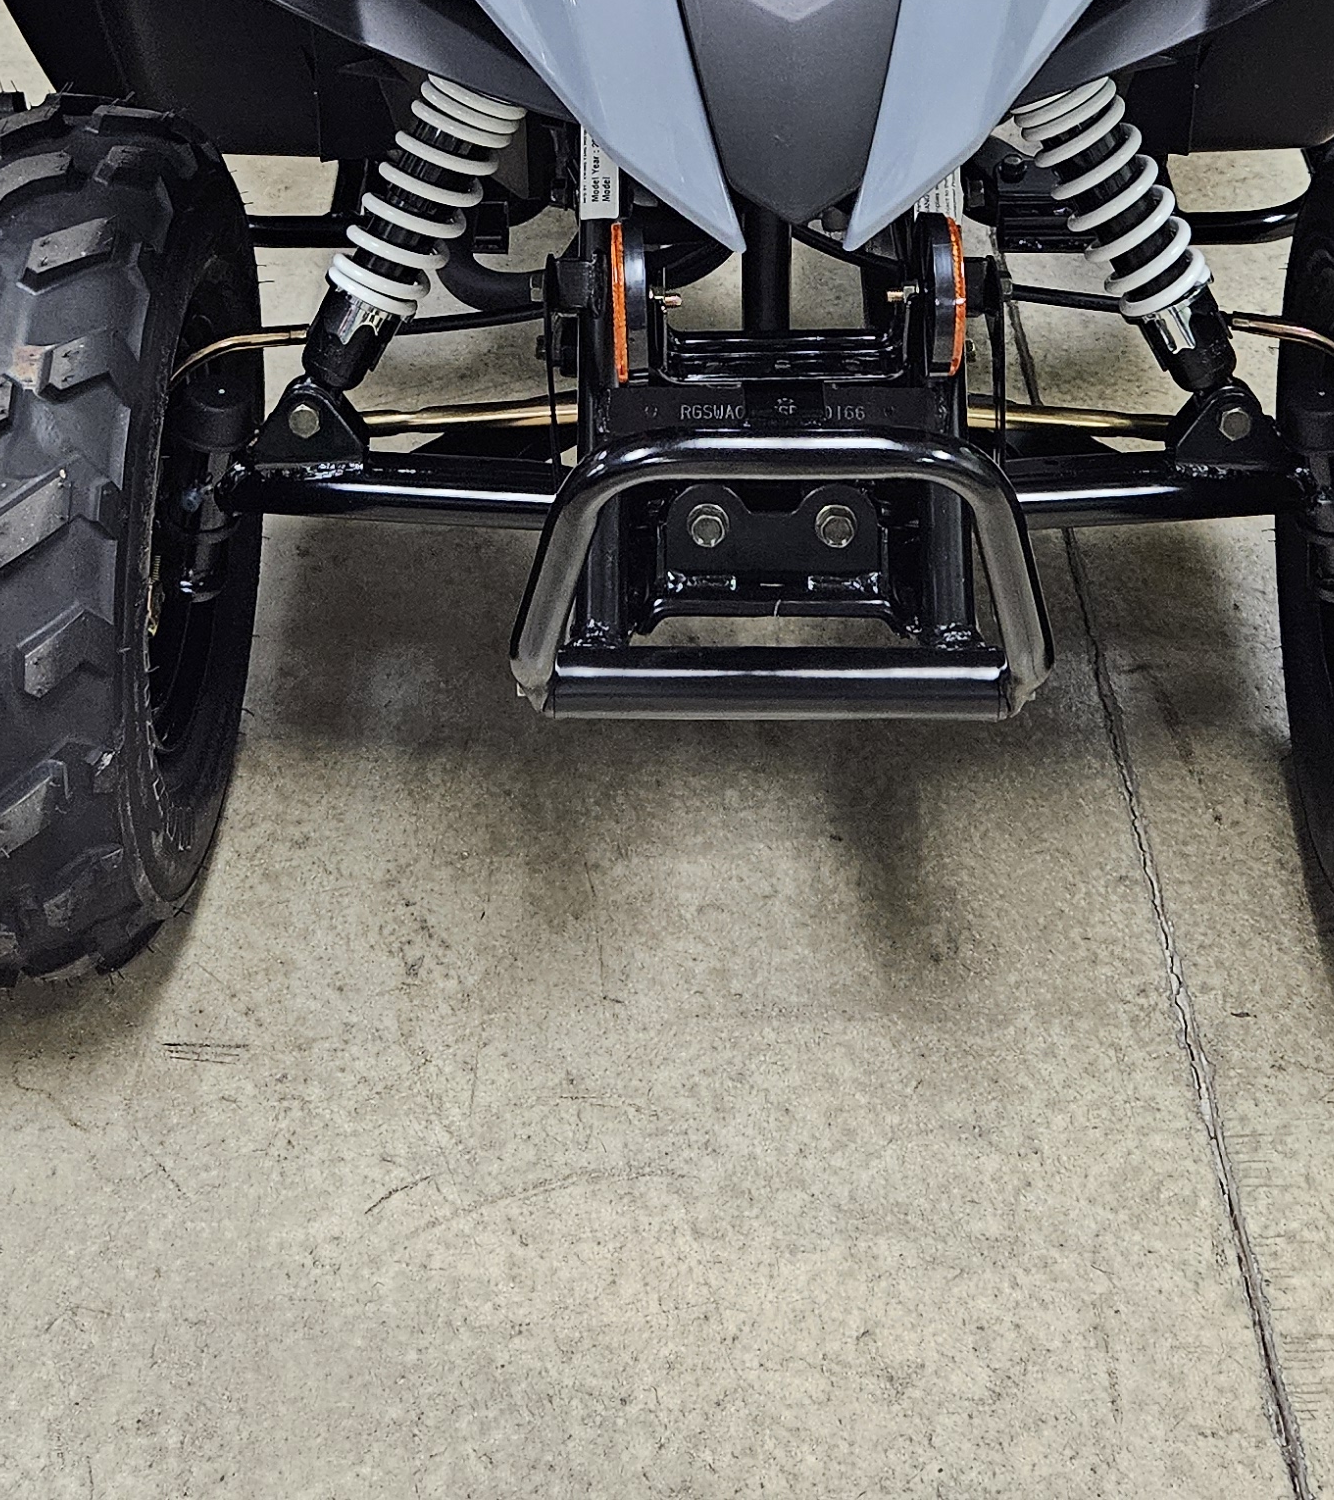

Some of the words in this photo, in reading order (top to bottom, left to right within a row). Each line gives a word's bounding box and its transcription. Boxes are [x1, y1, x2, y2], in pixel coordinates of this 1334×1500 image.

[591, 155, 599, 174] Year
[591, 176, 599, 201] Model
[602, 176, 610, 201] Model
